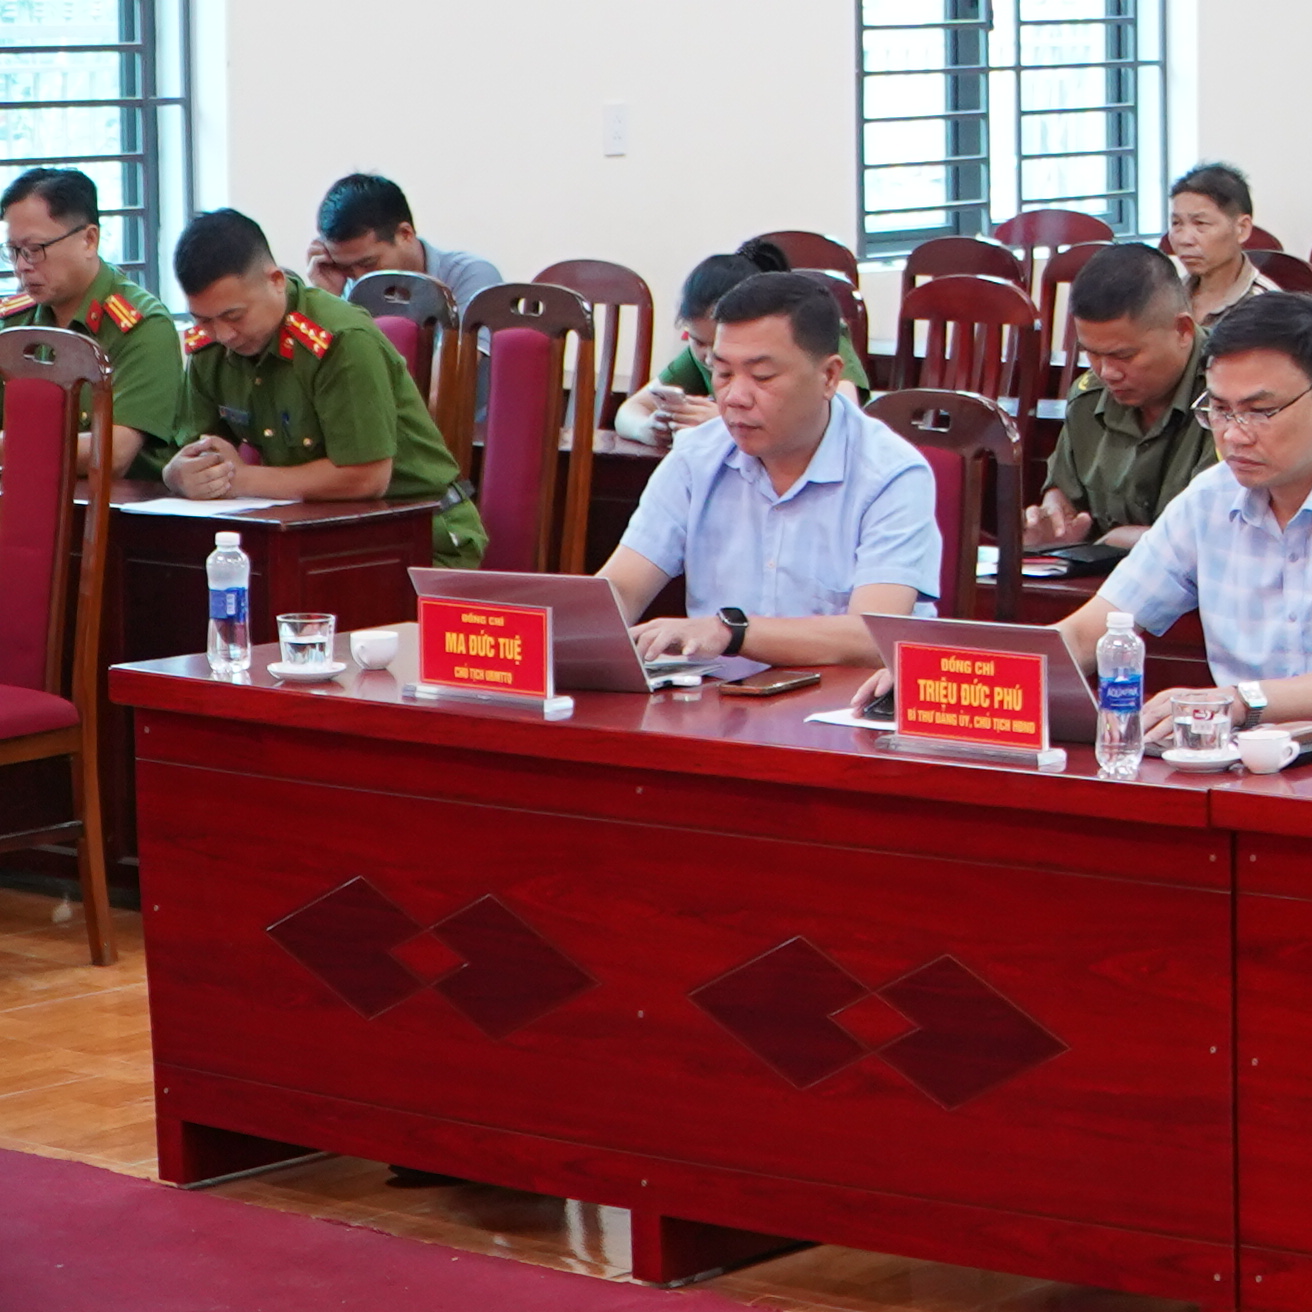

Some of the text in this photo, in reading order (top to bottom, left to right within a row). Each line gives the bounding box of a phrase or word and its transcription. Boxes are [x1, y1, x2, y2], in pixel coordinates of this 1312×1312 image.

[445, 630, 523, 665] MA ĐỨC TUỆ
[974, 660, 995, 677] CHÍ
[917, 677, 1023, 712] TRIỆU ĐỨC PHÚ
